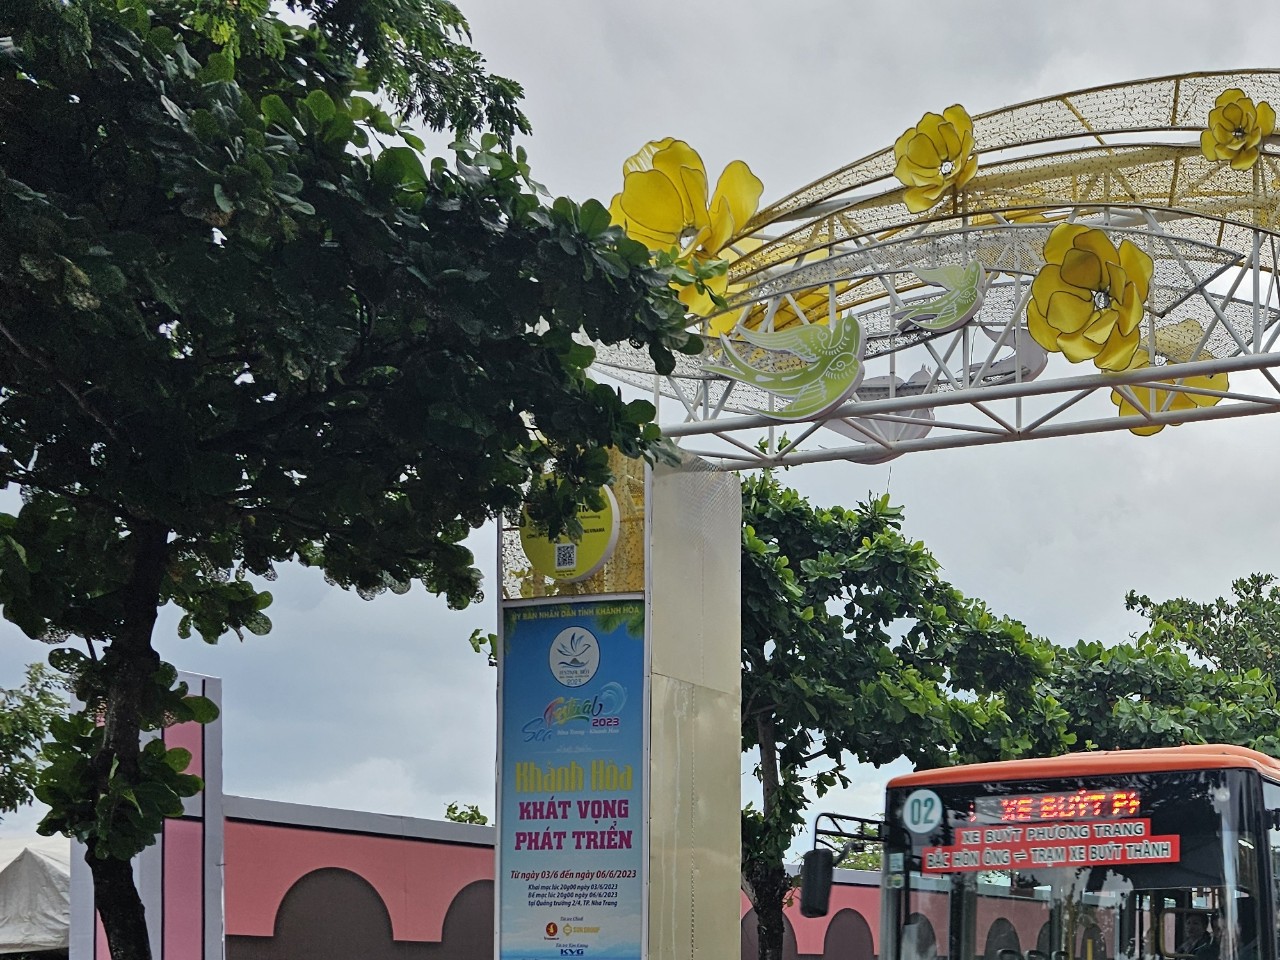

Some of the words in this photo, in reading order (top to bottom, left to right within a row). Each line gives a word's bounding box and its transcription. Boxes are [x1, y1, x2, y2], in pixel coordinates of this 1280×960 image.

[521, 718, 553, 742] Sea
[592, 717, 620, 727] 2023
[515, 760, 585, 793] Khánh
[590, 758, 633, 792] Hòa
[518, 795, 572, 820] KHÁT
[576, 799, 629, 824] VỌNG
[910, 798, 936, 826] 02
[1001, 797, 1033, 821] XE
[514, 826, 567, 851] PHÁT
[572, 820, 633, 850] TRIỂN
[961, 830, 980, 845] XE
[984, 826, 1023, 844] BUÝT
[1026, 823, 1090, 842] PHƯƠNG
[1092, 821, 1145, 838] TRANG
[926, 848, 951, 869] BẮC
[952, 849, 980, 868] HÒN
[983, 846, 1011, 866] ÔNG
[1031, 846, 1066, 868] TRẠM
[1069, 844, 1087, 862] XE
[1089, 840, 1123, 860] BUÝT
[1126, 840, 1172, 860] THÀNH
[510, 870, 520, 879] Từ
[520, 870, 541, 881] ngày
[541, 870, 559, 879] 03/6
[559, 869, 574, 879] đến
[575, 869, 596, 881] ngày
[596, 869, 637, 879] 06/6/2023
